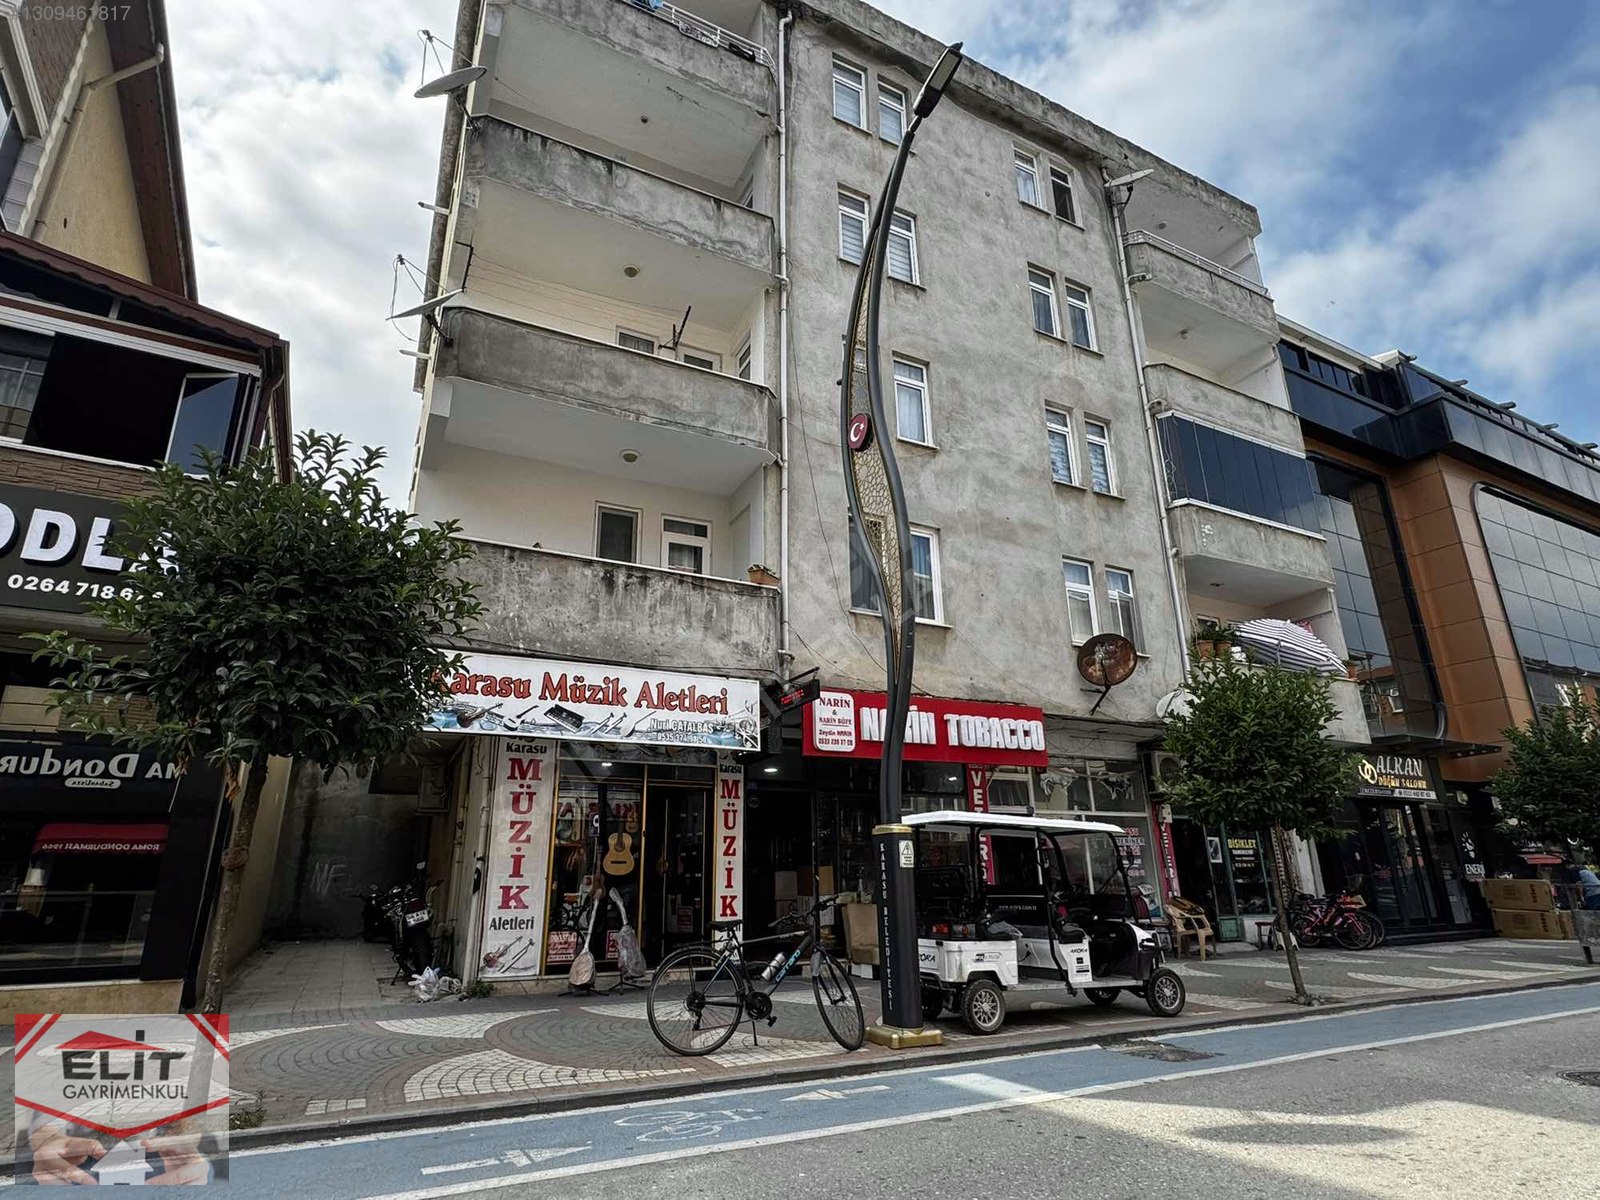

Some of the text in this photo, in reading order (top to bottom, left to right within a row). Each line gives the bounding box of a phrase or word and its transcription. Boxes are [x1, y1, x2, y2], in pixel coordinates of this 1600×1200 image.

[7, 574, 71, 595] 0264
[75, 582, 115, 600] 718
[538, 671, 628, 708] Müzik
[633, 681, 729, 716] Aletleri
[819, 696, 851, 708] NARİN
[943, 712, 1046, 751] TOBACCO
[506, 742, 548, 755] Karasu
[719, 763, 743, 775] Karasu
[1376, 755, 1424, 777] ALKAN
[497, 758, 543, 910] MÜZİK
[719, 779, 741, 917] MÜZİK
[489, 916, 535, 932] Aletleri
[919, 954, 936, 962] ORA
